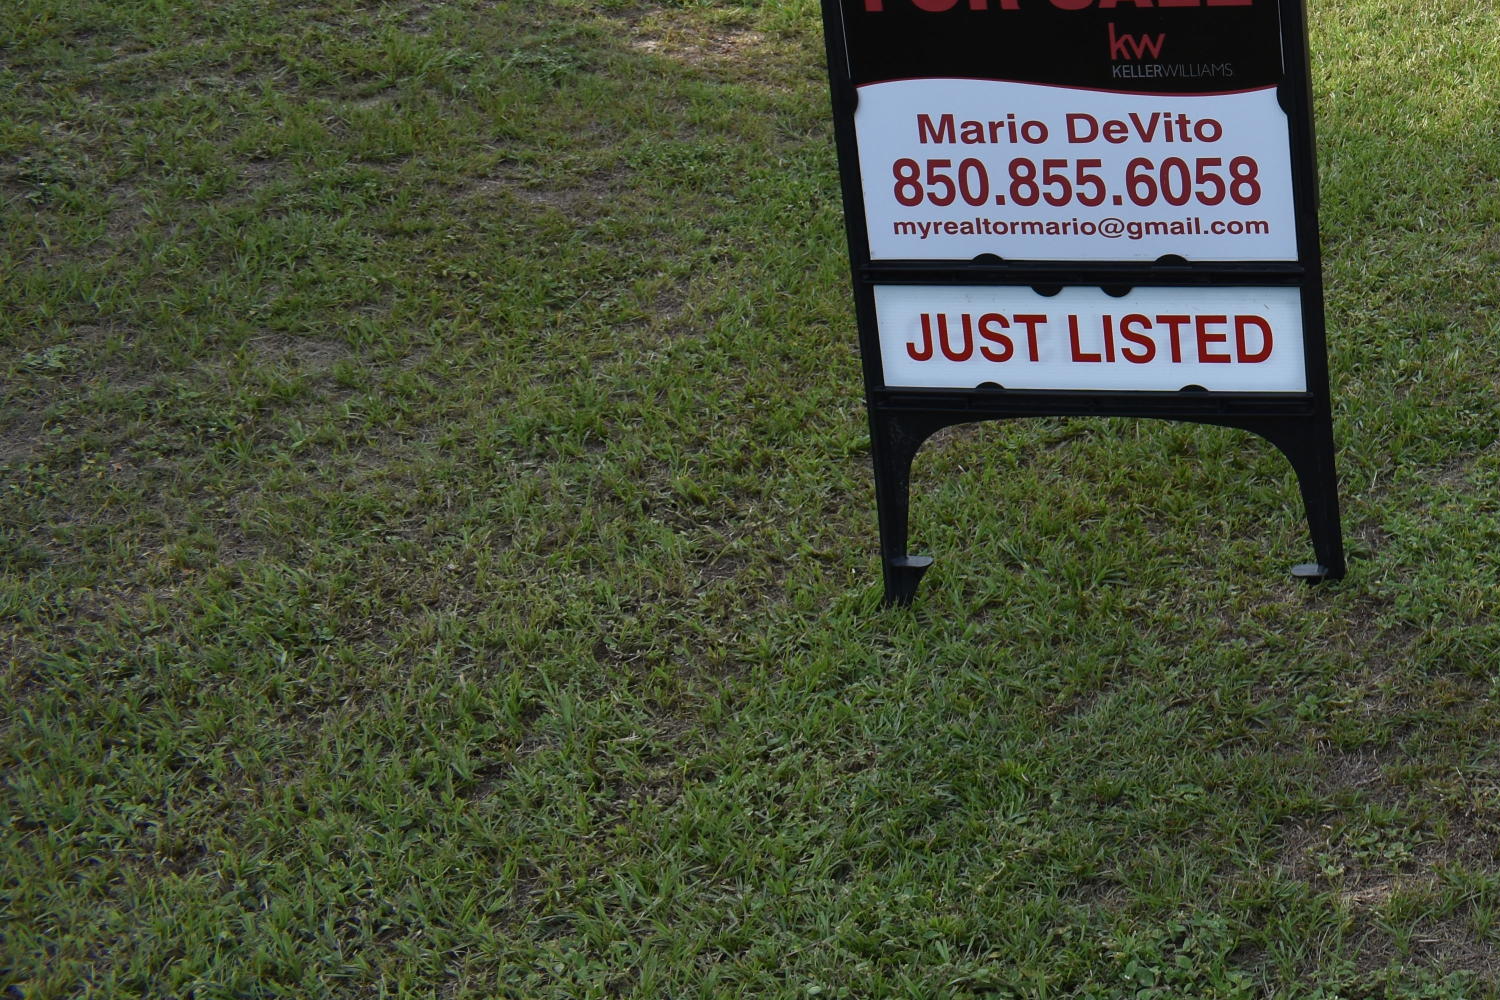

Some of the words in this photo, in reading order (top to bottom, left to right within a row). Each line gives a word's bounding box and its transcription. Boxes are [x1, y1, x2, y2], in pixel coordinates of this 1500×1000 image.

[1107, 22, 1166, 60] kw
[916, 113, 1049, 145] Mario
[1066, 112, 1223, 144] DeVito
[892, 155, 1262, 207] 850.855.6058
[892, 217, 1270, 240] myrealtormario@gmail.com
[906, 312, 1048, 363] JUST
[1067, 312, 1275, 364] LISTED
